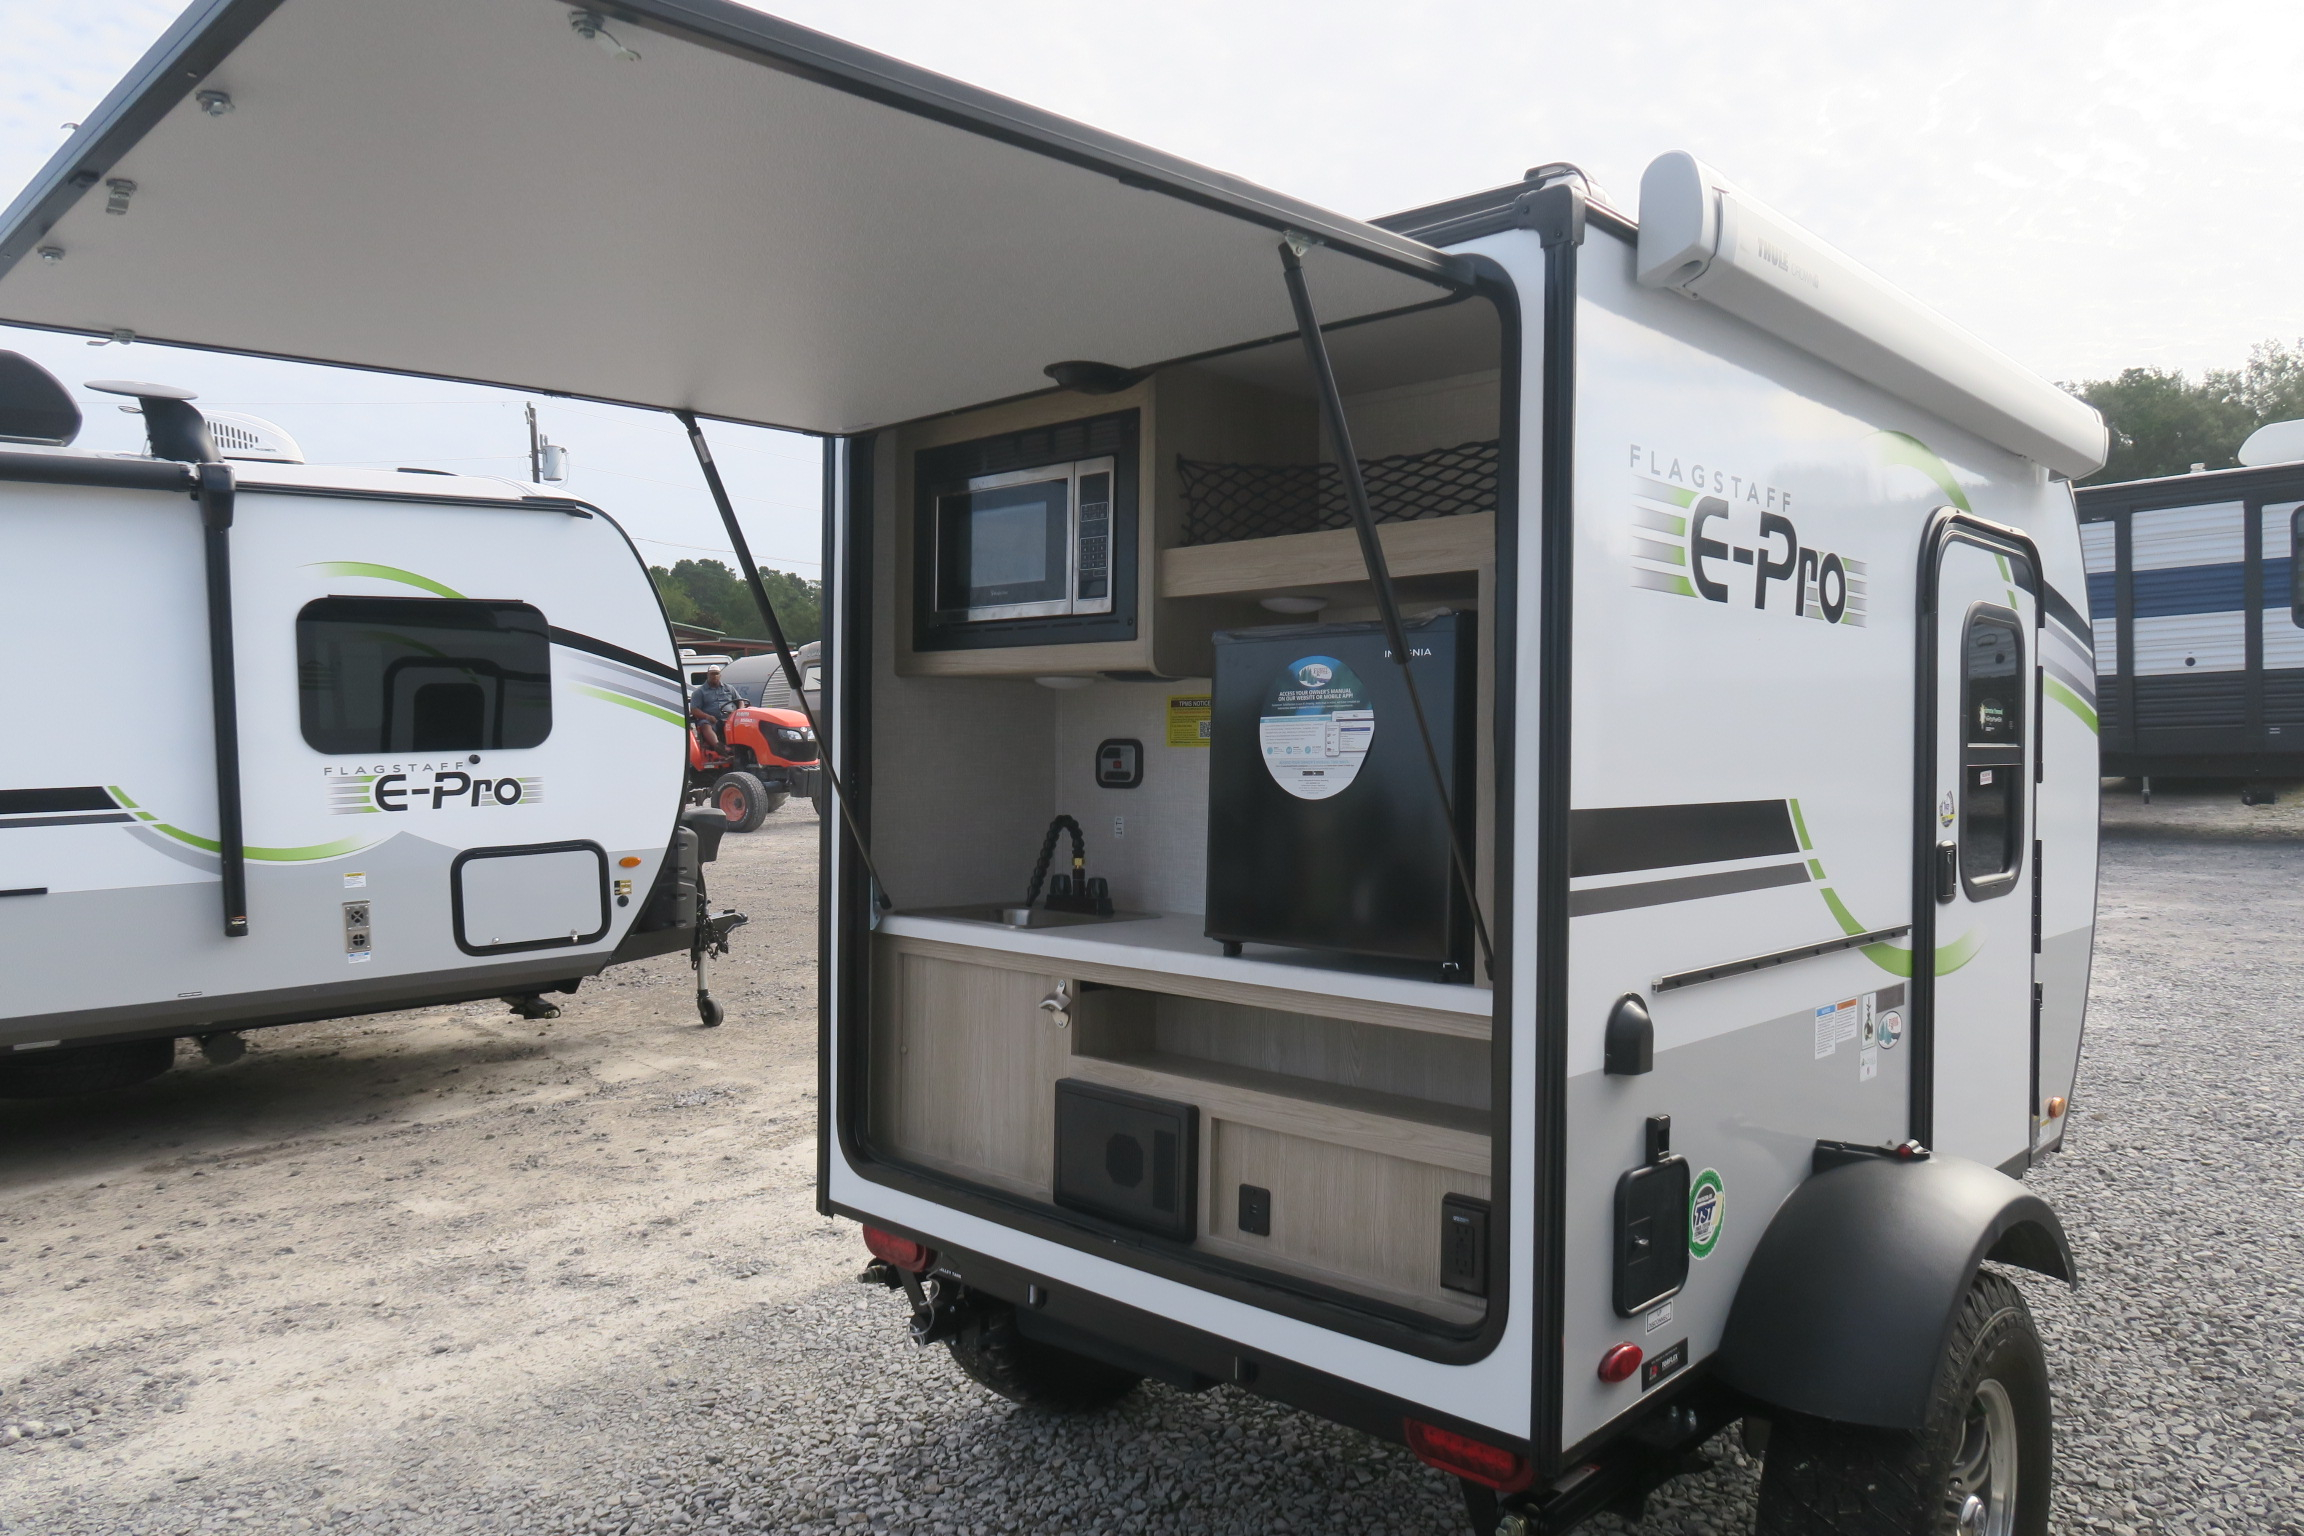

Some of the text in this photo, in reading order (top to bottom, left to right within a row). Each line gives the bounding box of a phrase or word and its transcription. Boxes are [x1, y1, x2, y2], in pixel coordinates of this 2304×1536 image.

[1630, 443, 1791, 512] FLAGSTAFF
[1691, 495, 1847, 624] E-Pro
[324, 761, 464, 776] FLAGSTAFF
[375, 771, 522, 812] E-Pro
[1696, 1200, 1717, 1226] TST
